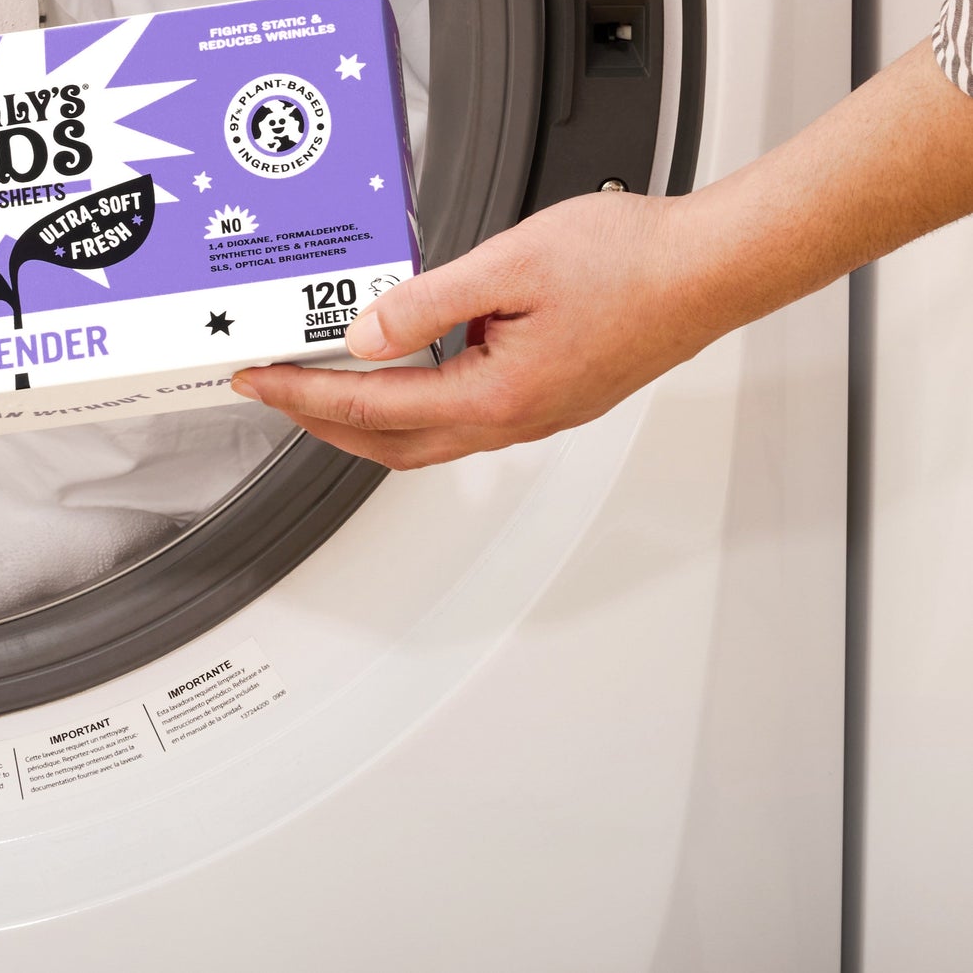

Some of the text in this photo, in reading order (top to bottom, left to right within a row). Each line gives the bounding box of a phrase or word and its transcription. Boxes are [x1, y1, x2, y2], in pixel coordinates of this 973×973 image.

[198, 23, 336, 52] REDUCES WRINKLES
[209, 13, 322, 38] FIGHTS STATIC &
[238, 79, 324, 118] PLANT-BASED
[237, 135, 323, 173] INGREDIENTS
[39, 191, 142, 245] ULTRA-SOFT
[91, 221, 101, 234] &
[220, 217, 242, 234] NO
[70, 221, 133, 260] FRESH
[209, 232, 374, 262] SYNTHETIC DYES & FRAGRANCES,
[227, 235, 274, 248] DIOXANE,
[276, 223, 359, 242] FORMALDEHYDE,
[210, 247, 347, 273] SLS, OPTICAL BRIGHTENERS
[301, 279, 357, 311] 120
[305, 307, 359, 327] SHEETS
[308, 329, 332, 340] MADE
[332, 328, 342, 337] IN
[33, 393, 152, 419] WITHOUT
[156, 377, 233, 394] COMP
[167, 660, 232, 699] IMPORTANTE
[49, 717, 110, 745] IMPORTANT
